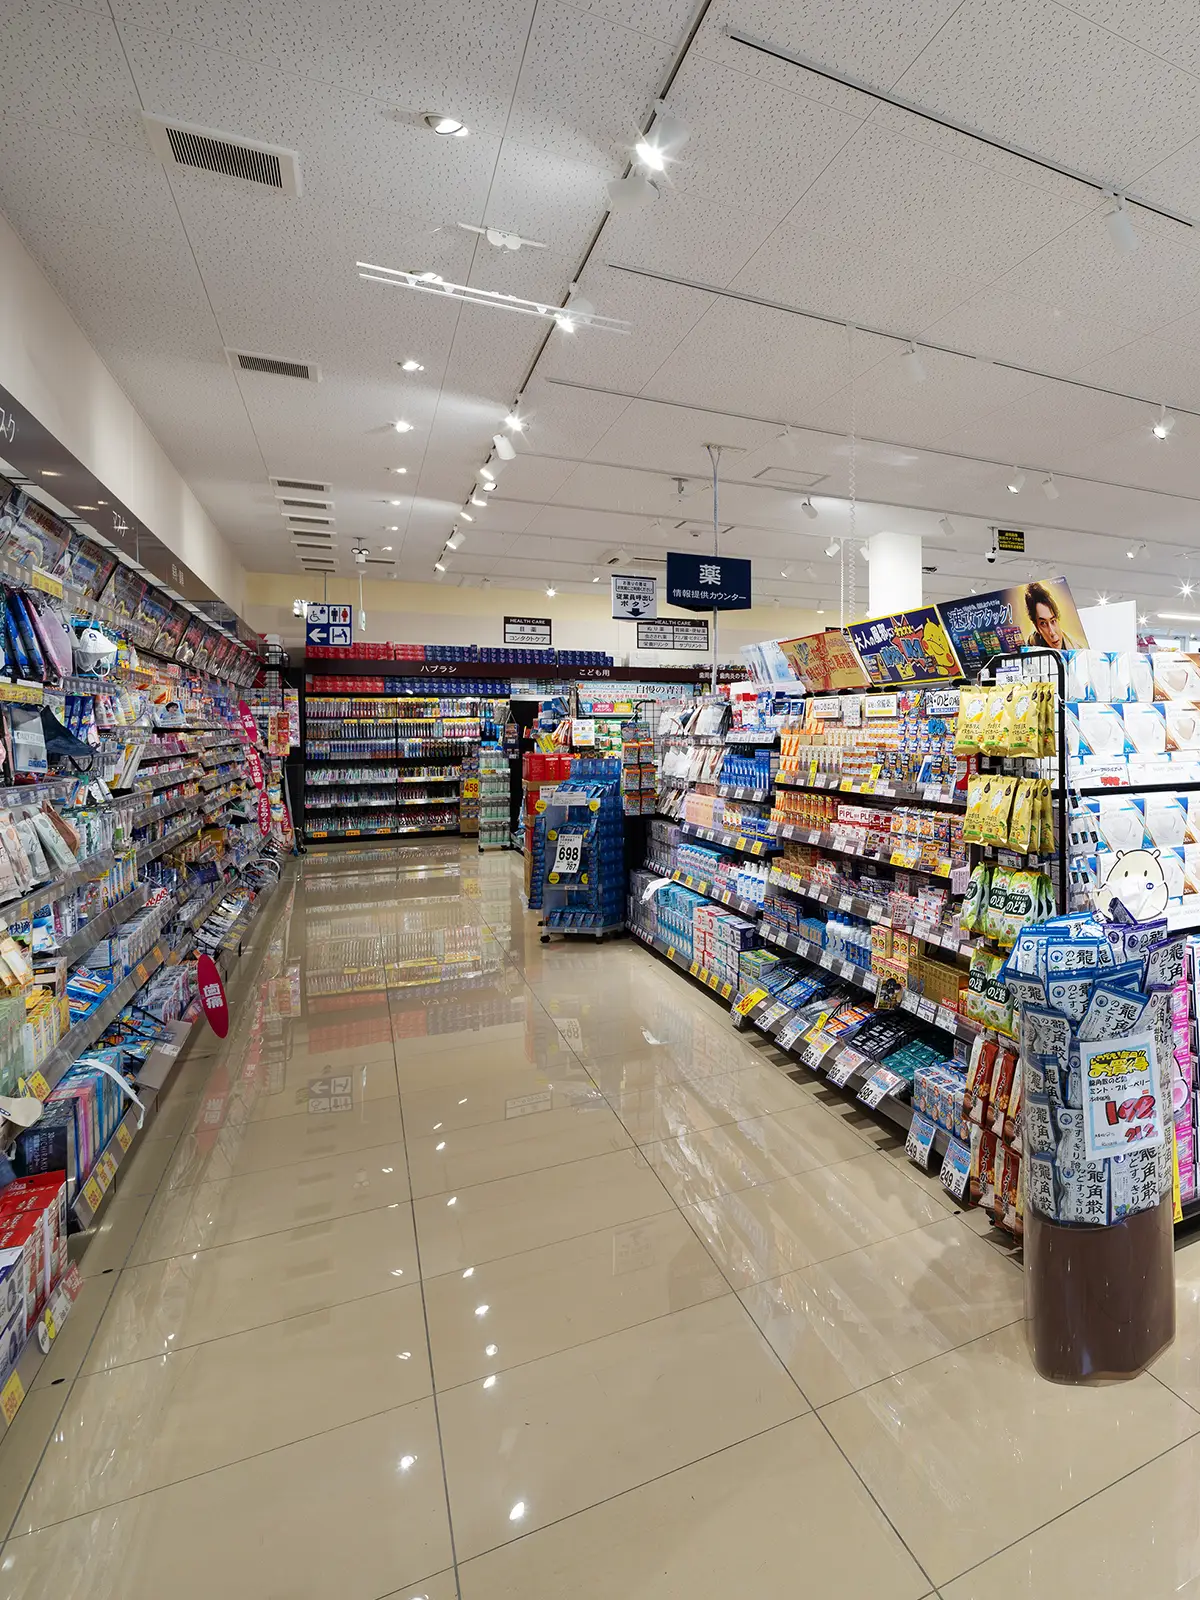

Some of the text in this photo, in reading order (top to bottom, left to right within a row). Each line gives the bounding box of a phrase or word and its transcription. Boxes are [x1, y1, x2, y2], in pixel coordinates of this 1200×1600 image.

[699, 563, 722, 586] 薬
[672, 588, 747, 602] 情報提供カウンター
[420, 665, 457, 673] ハブラシ
[579, 669, 610, 677] こども用
[464, 783, 478, 793] 458
[558, 846, 579, 862] 698
[566, 863, 577, 871] 767
[1006, 901, 1027, 914] のど飴
[202, 983, 224, 1010] 歯痛
[940, 1166, 953, 1188] 249
